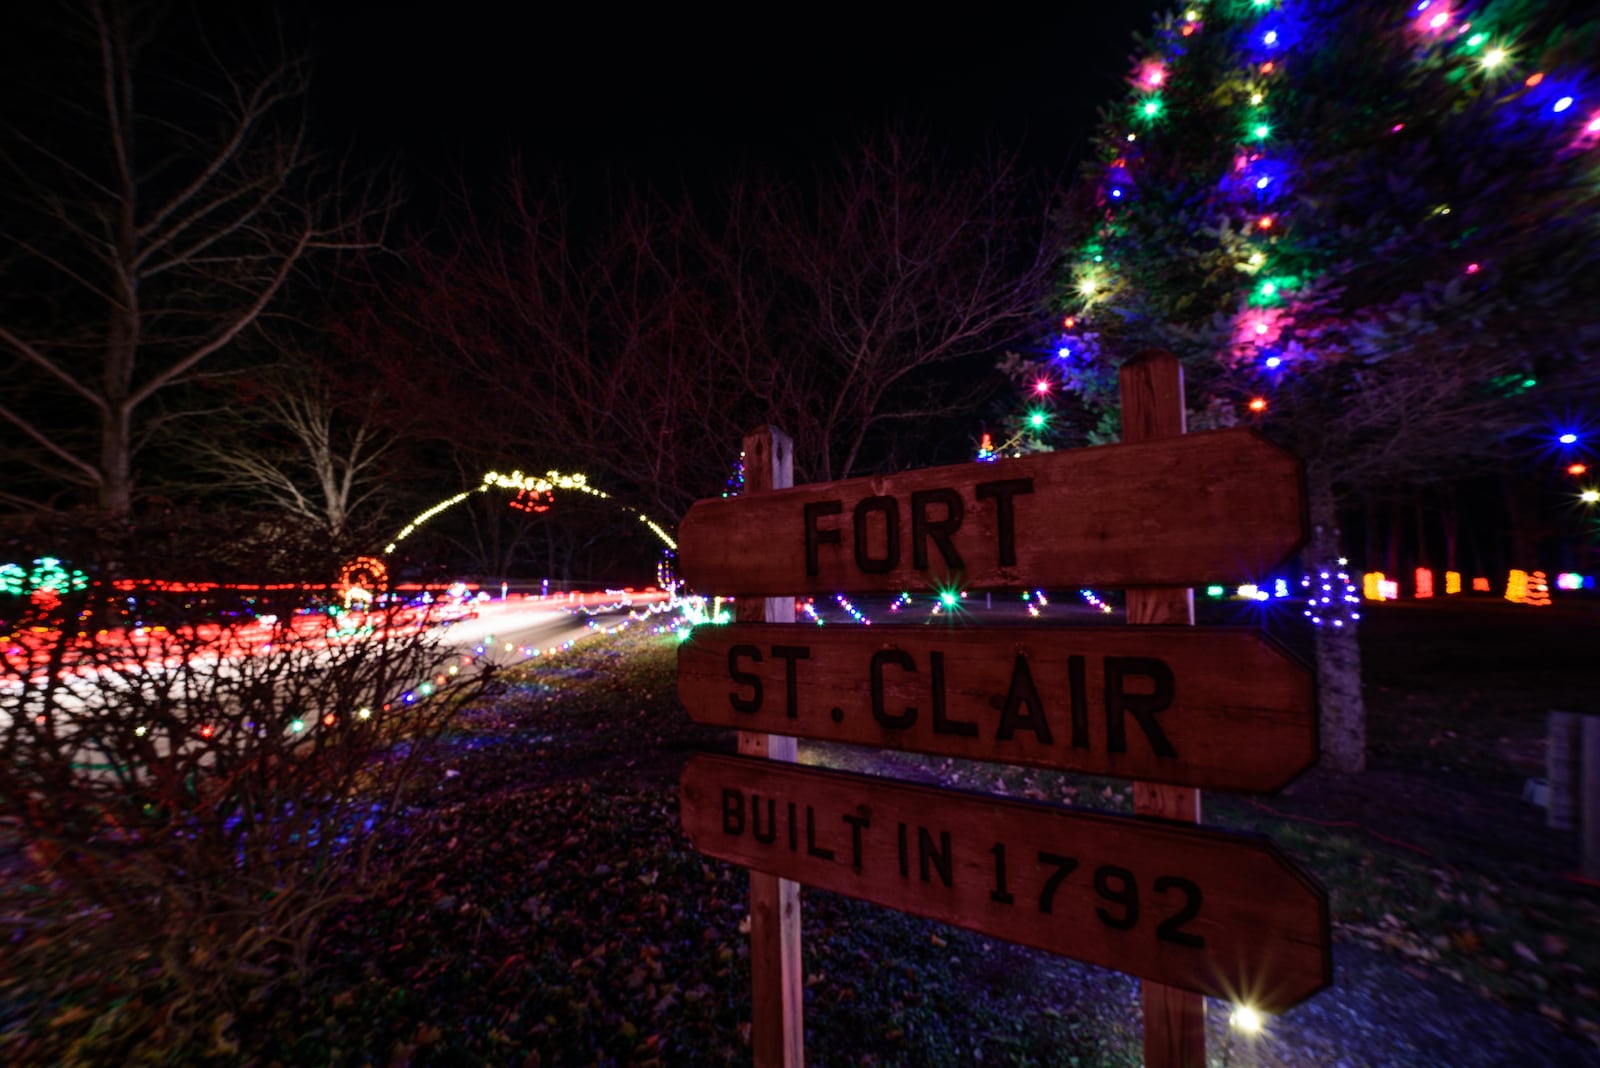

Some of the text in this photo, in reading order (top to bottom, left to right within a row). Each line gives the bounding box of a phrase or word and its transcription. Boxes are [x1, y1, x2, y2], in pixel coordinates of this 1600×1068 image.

[804, 477, 1034, 576] FORT
[870, 648, 1178, 759] CLAIR
[722, 789, 1206, 948] BUILT IN 1792
